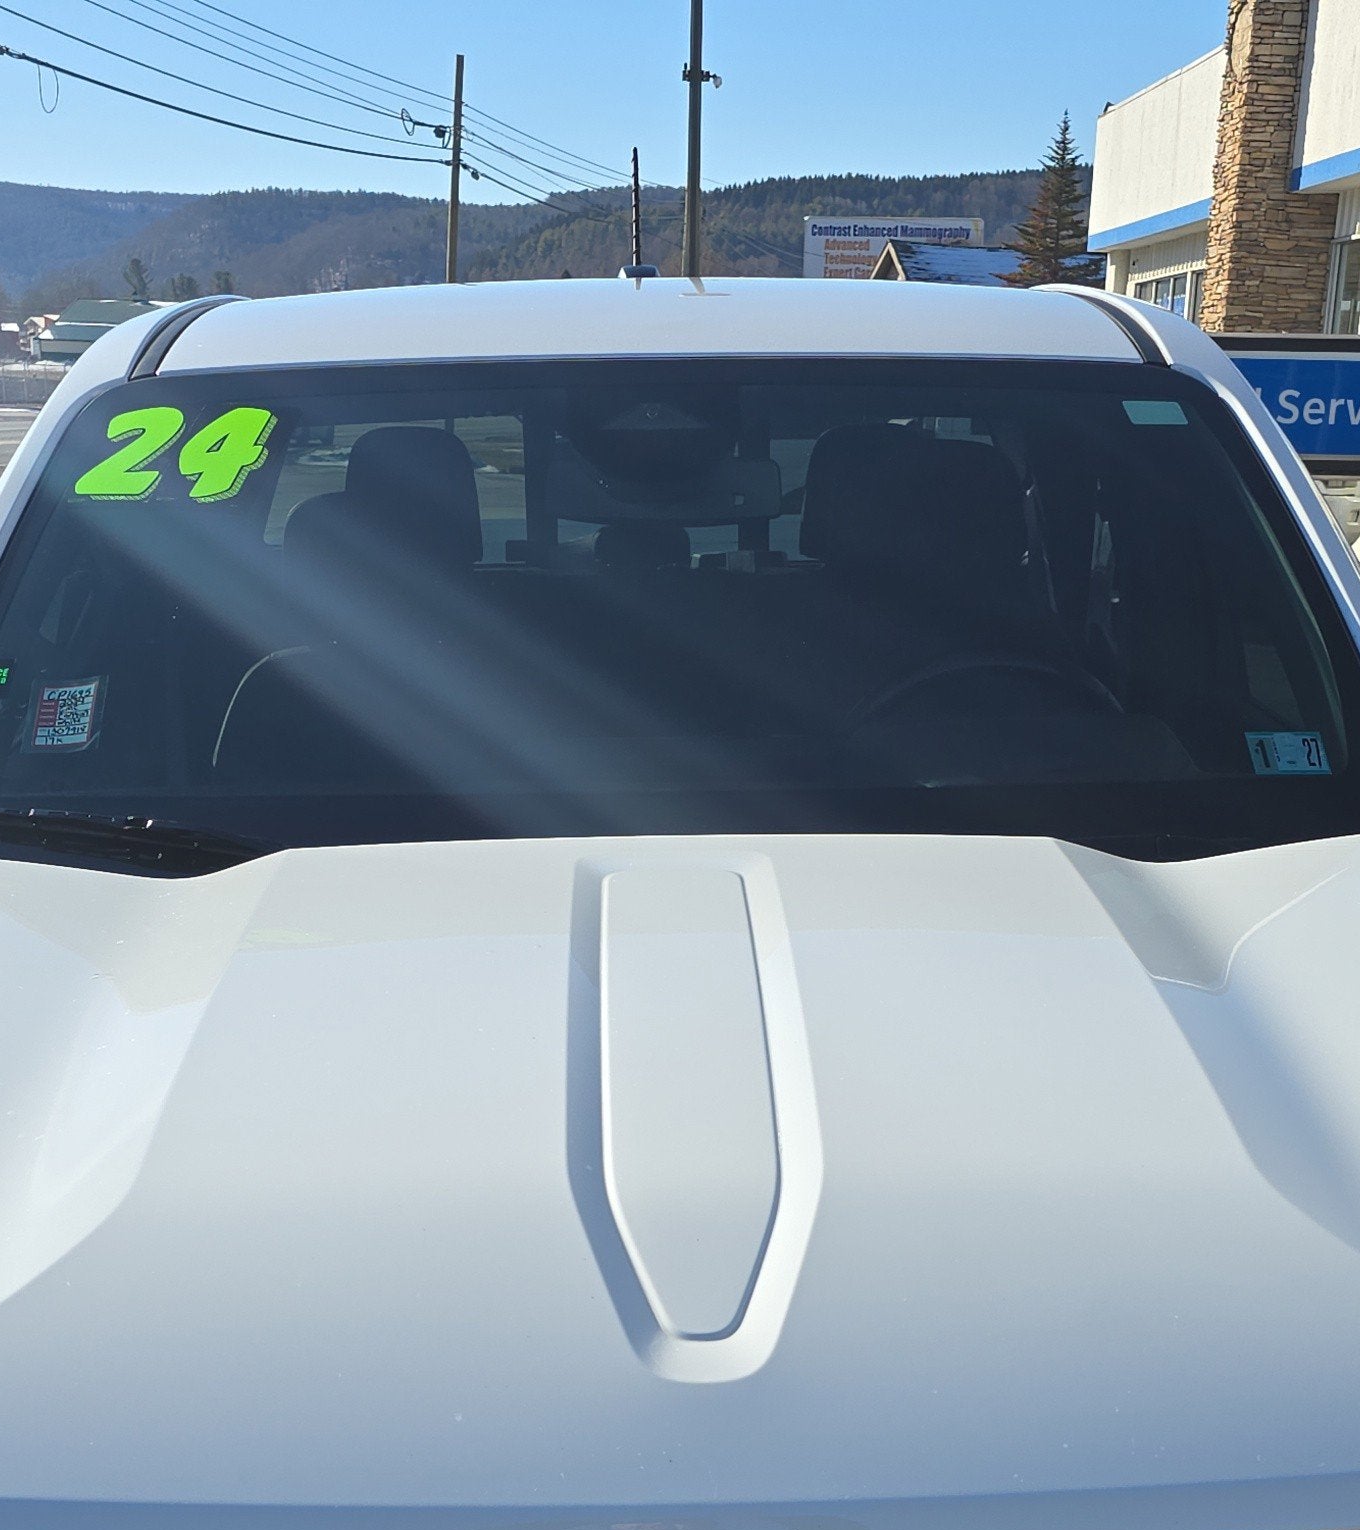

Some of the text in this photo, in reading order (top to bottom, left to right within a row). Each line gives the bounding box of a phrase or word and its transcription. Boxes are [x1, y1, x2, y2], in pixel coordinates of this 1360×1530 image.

[811, 224, 971, 240] Contrast Enhanced Mammography
[824, 239, 870, 251] Advanced
[75, 407, 278, 503] 24
[1301, 738, 1322, 768] 27
